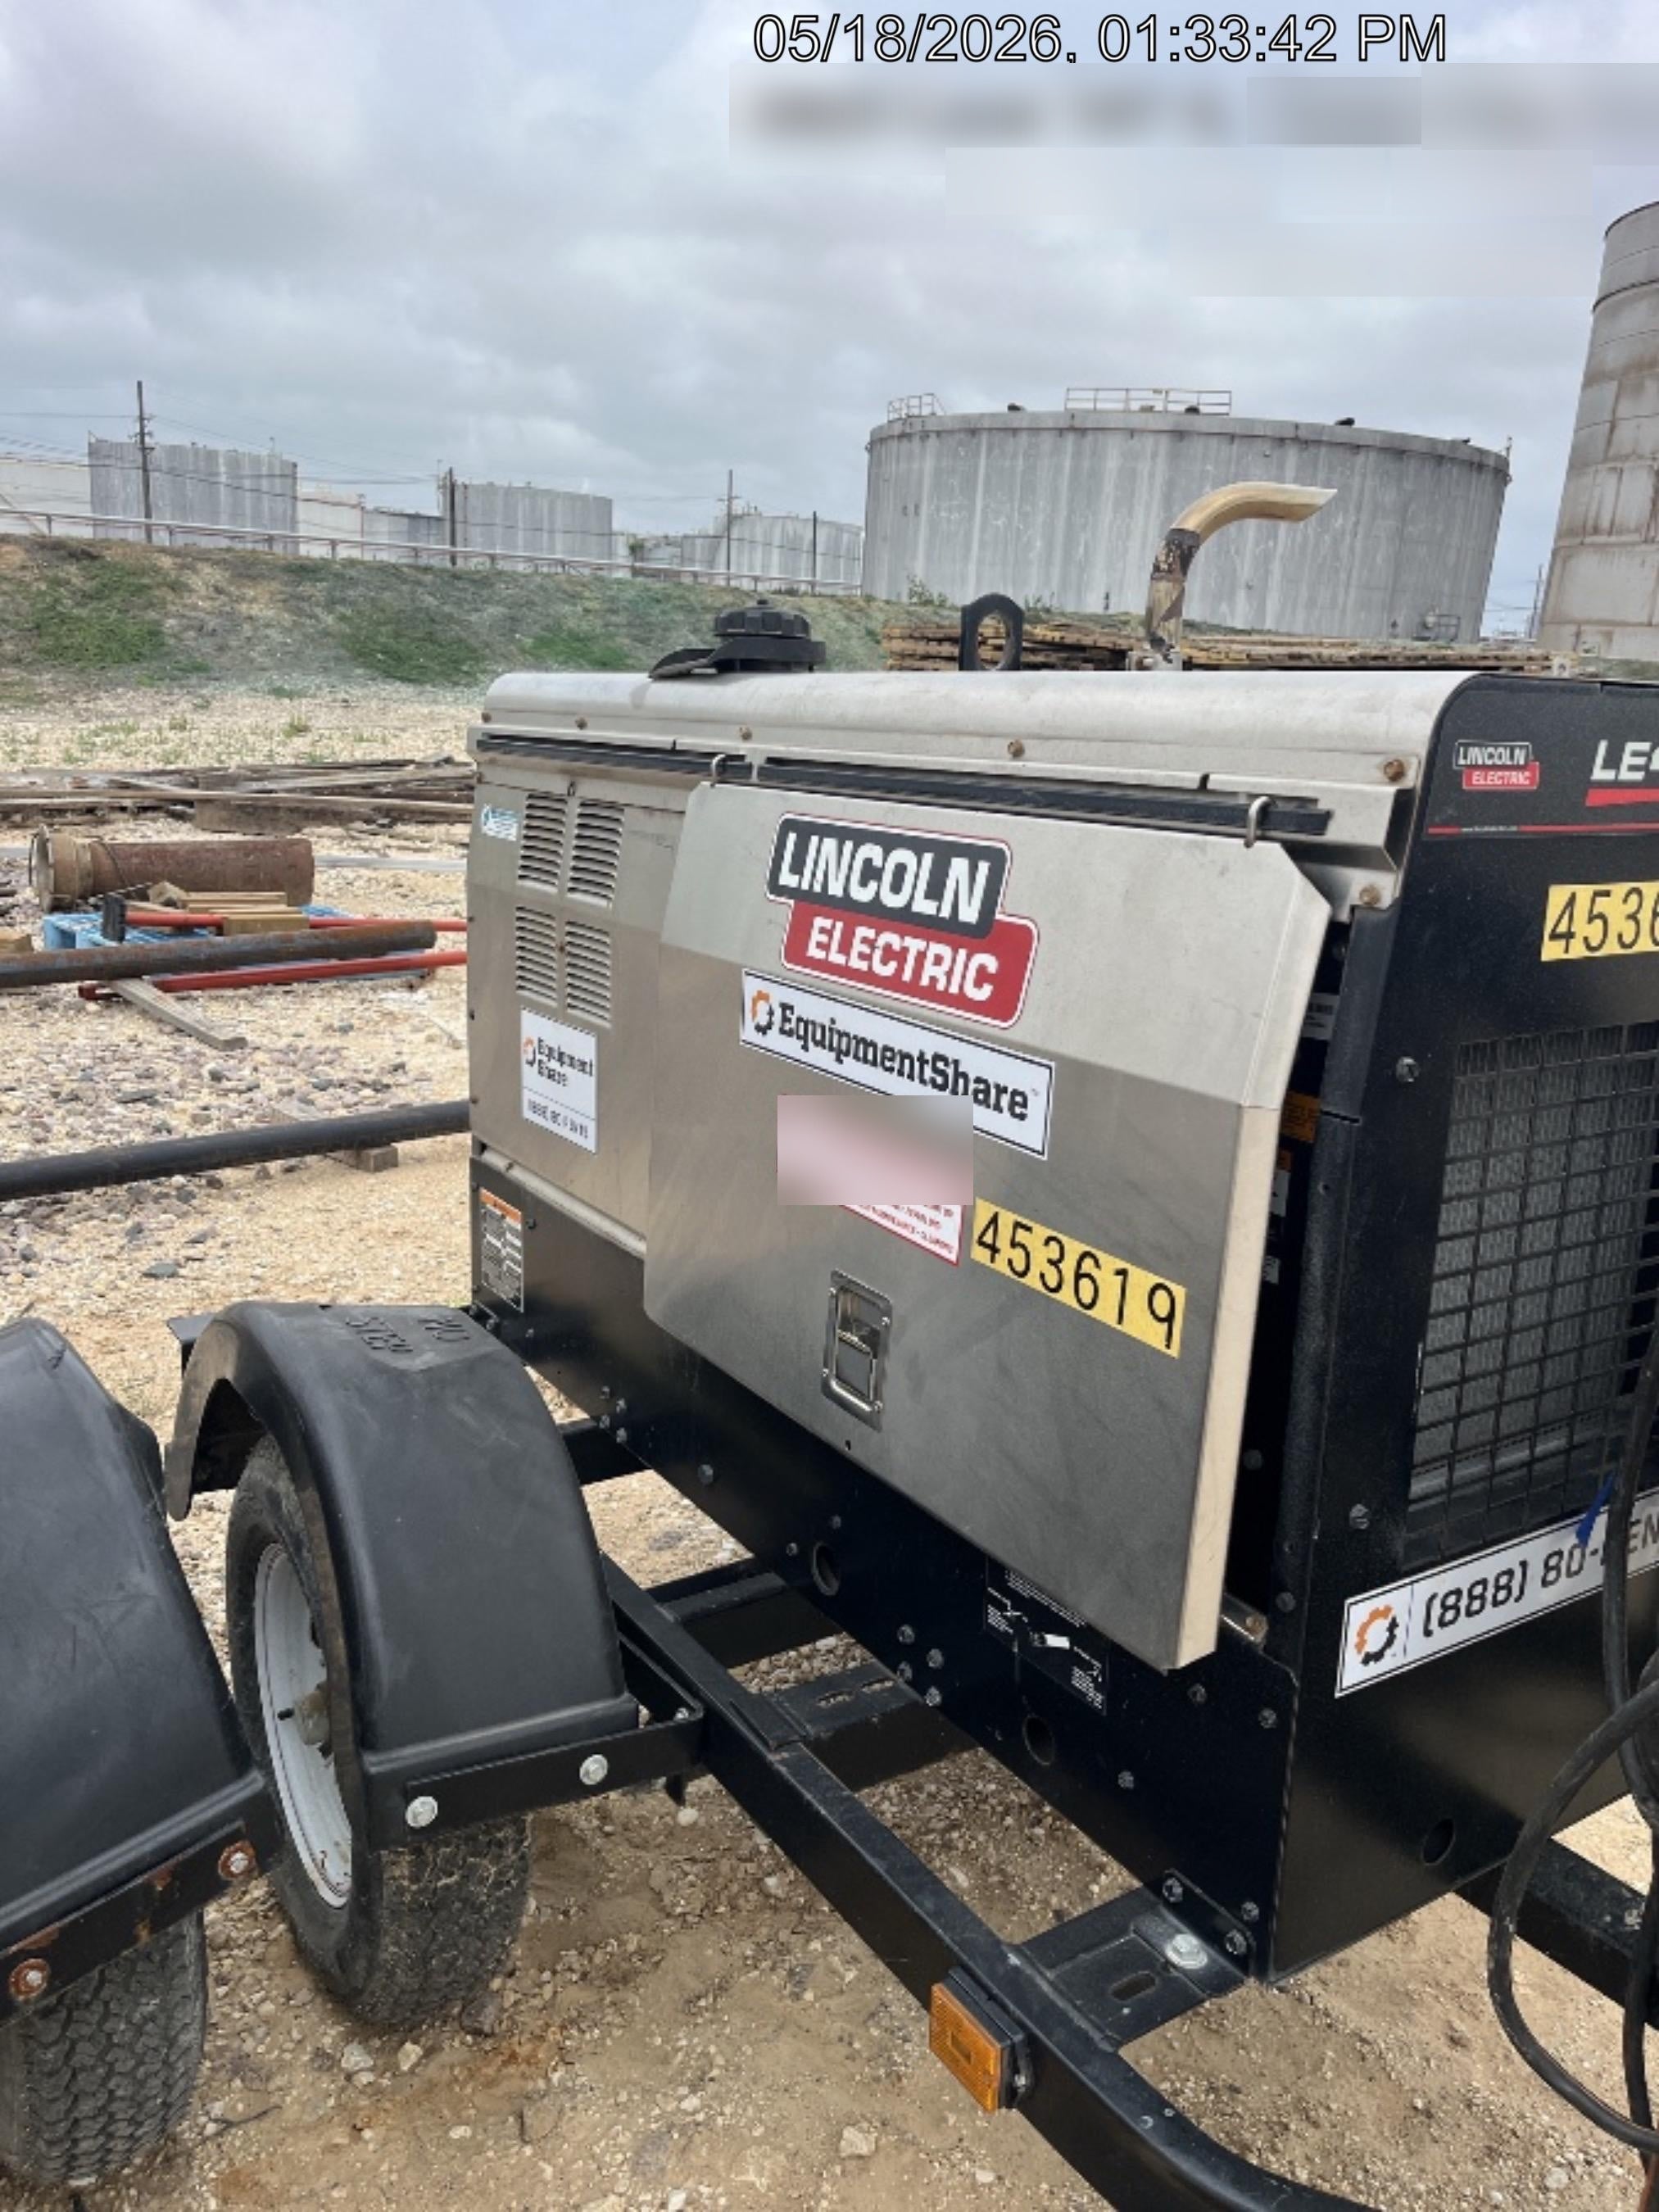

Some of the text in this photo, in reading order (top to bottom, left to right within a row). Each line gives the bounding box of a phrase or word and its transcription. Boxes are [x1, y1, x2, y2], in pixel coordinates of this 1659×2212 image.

[1457, 746, 1528, 766] LINCOLN
[1471, 771, 1531, 786] ELECTRIC
[777, 832, 991, 925] LINCOLN
[805, 916, 999, 1002] ELECTRIC
[778, 1002, 1029, 1122] EquipmentShare
[977, 1211, 1176, 1350] 453619
[1423, 1560, 1528, 1638] (888)
